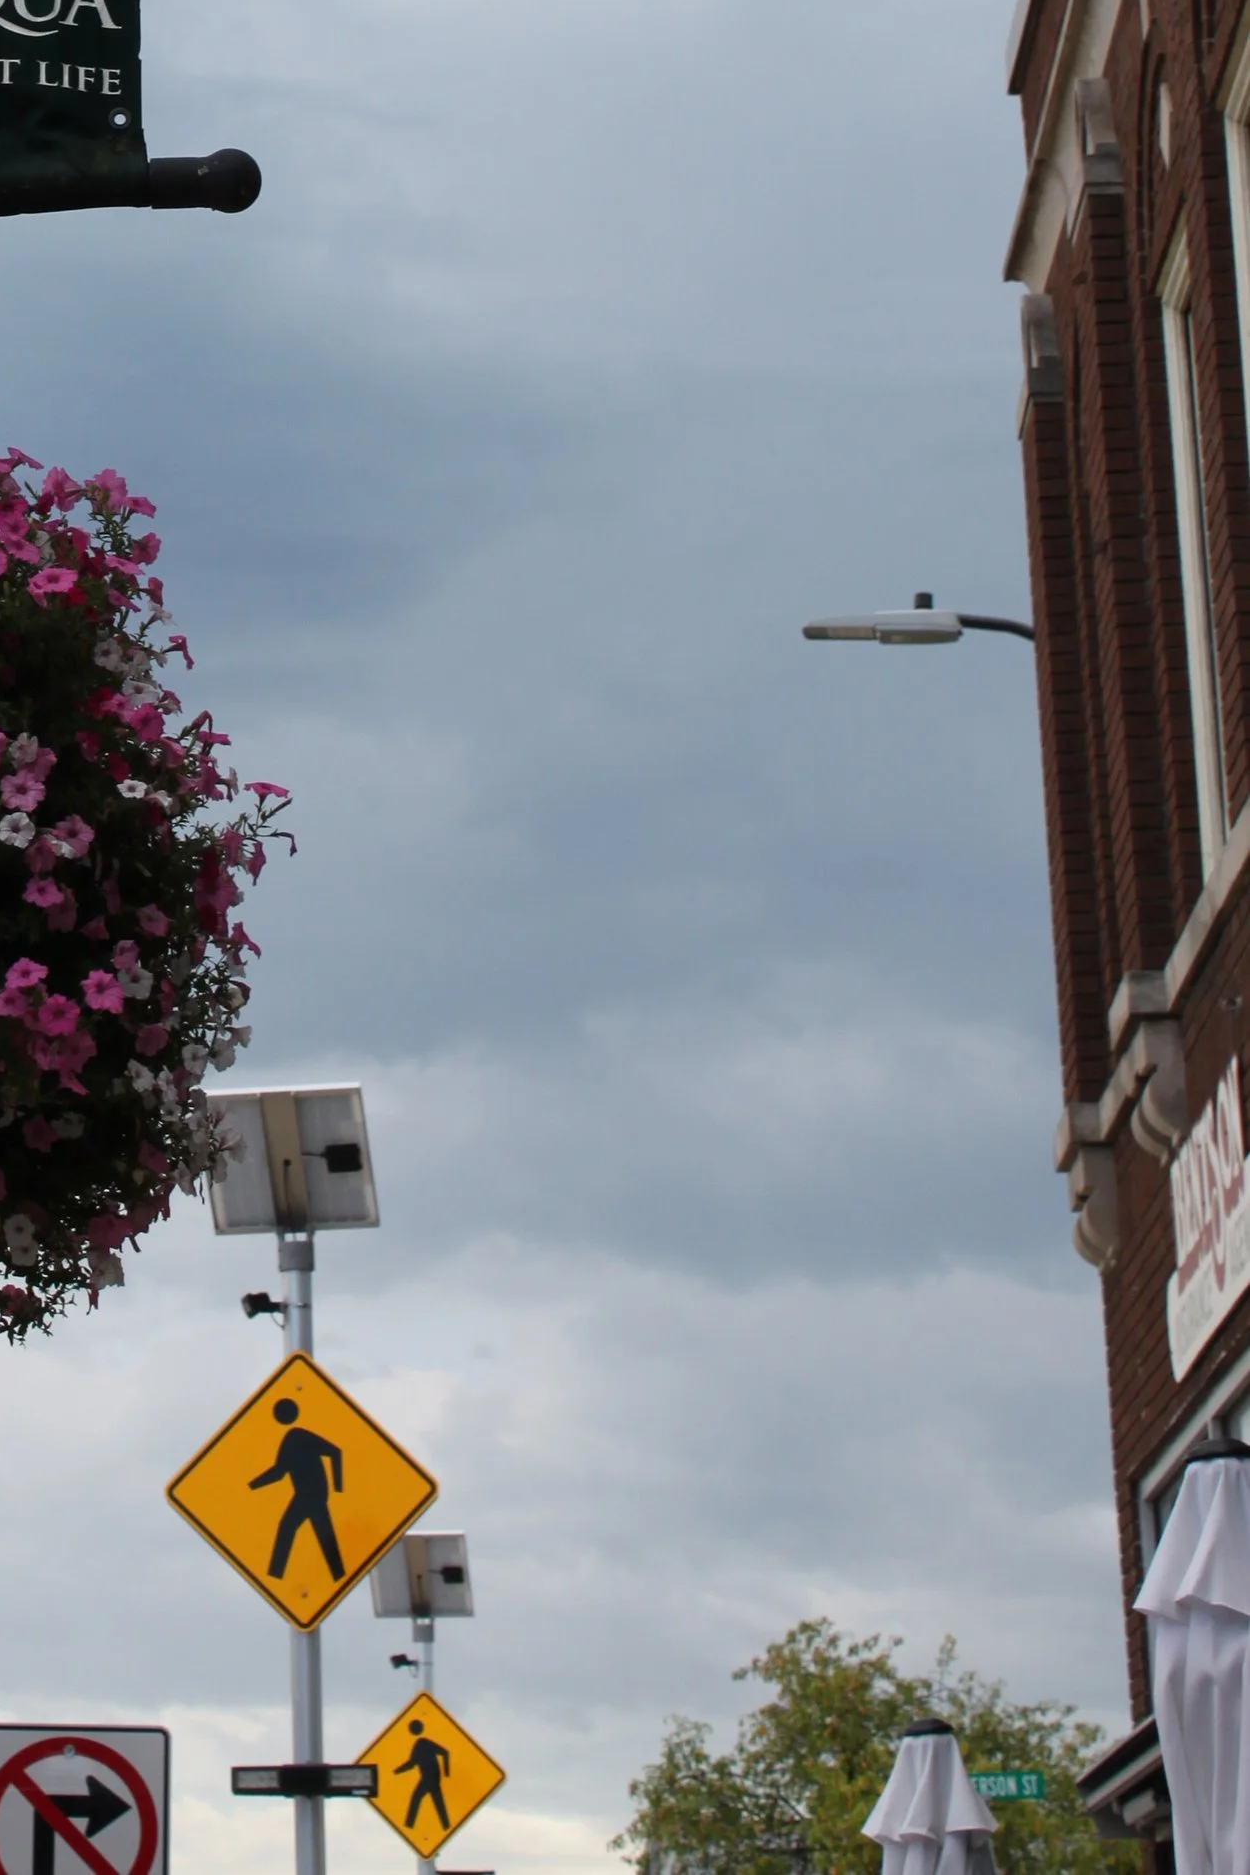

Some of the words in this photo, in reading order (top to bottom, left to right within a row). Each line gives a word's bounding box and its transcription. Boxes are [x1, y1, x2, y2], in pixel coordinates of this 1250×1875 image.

[36, 60, 123, 96] LIFE
[970, 1776, 1017, 1797] ERSON
[1021, 1775, 1038, 1795] ST
